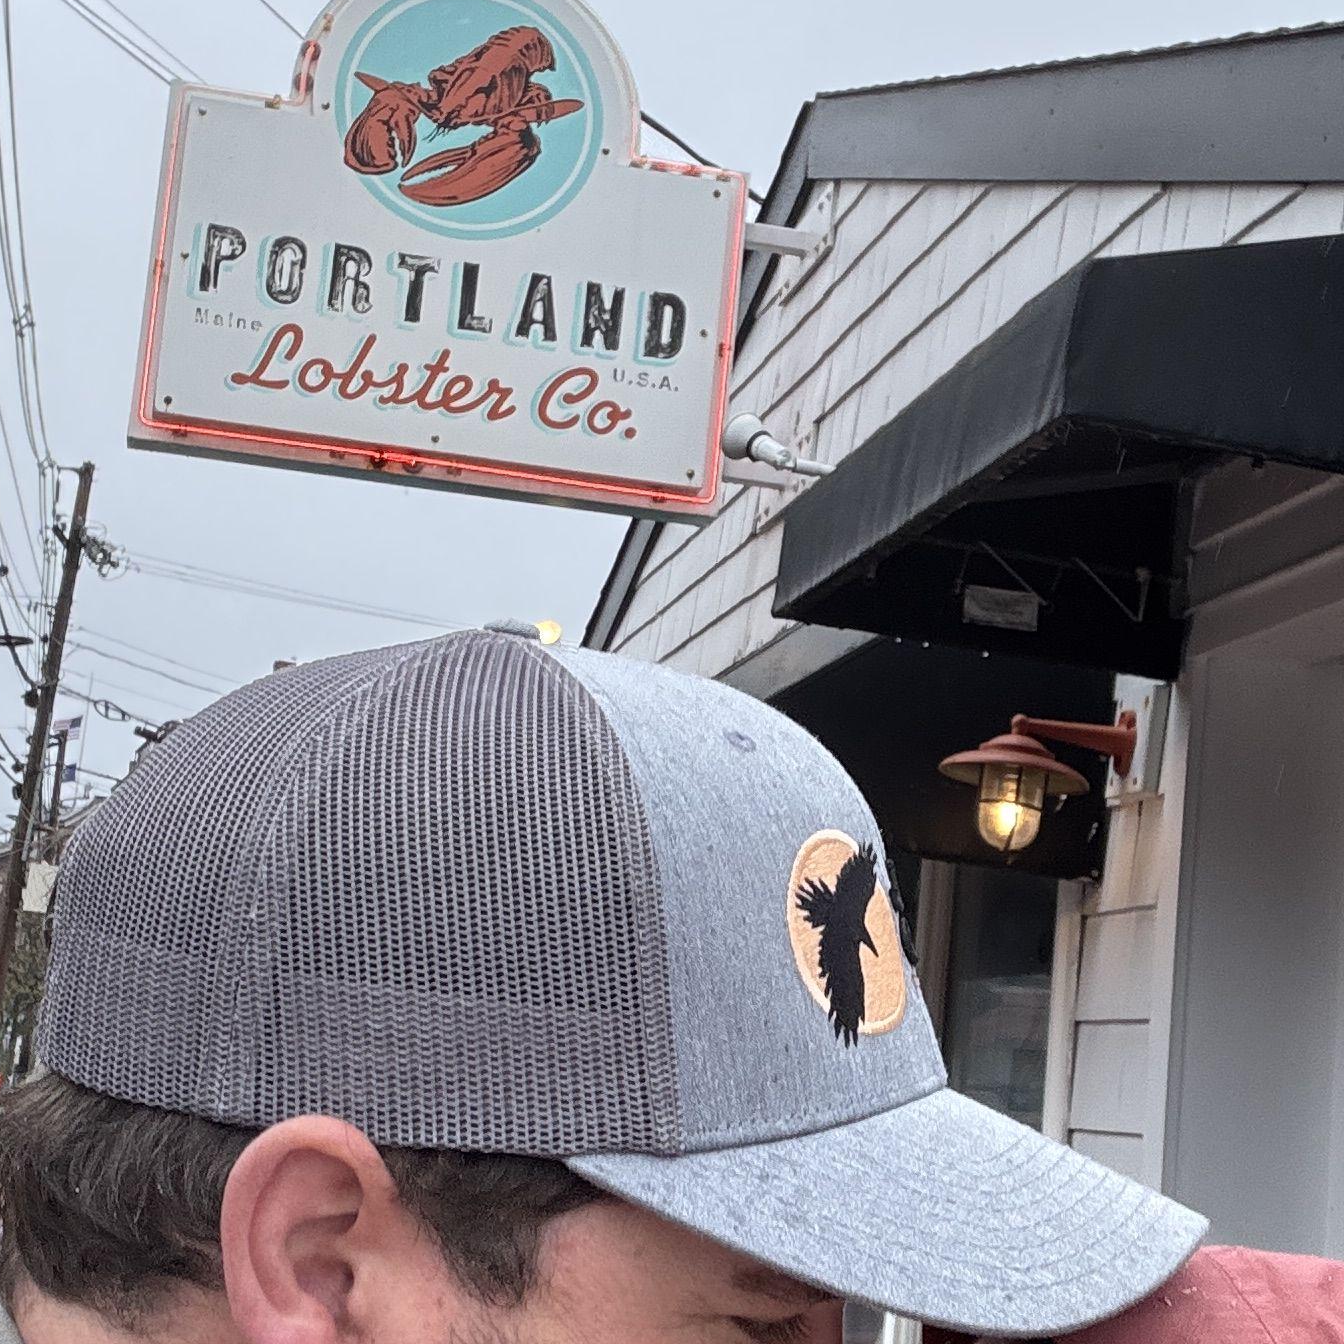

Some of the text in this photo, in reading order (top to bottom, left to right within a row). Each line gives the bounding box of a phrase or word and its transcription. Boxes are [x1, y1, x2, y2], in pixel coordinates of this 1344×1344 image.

[194, 306, 264, 333] Maine
[197, 222, 687, 360] PORTLAND
[229, 322, 638, 440] Lobster Co.
[612, 367, 680, 393] U.S.A.
